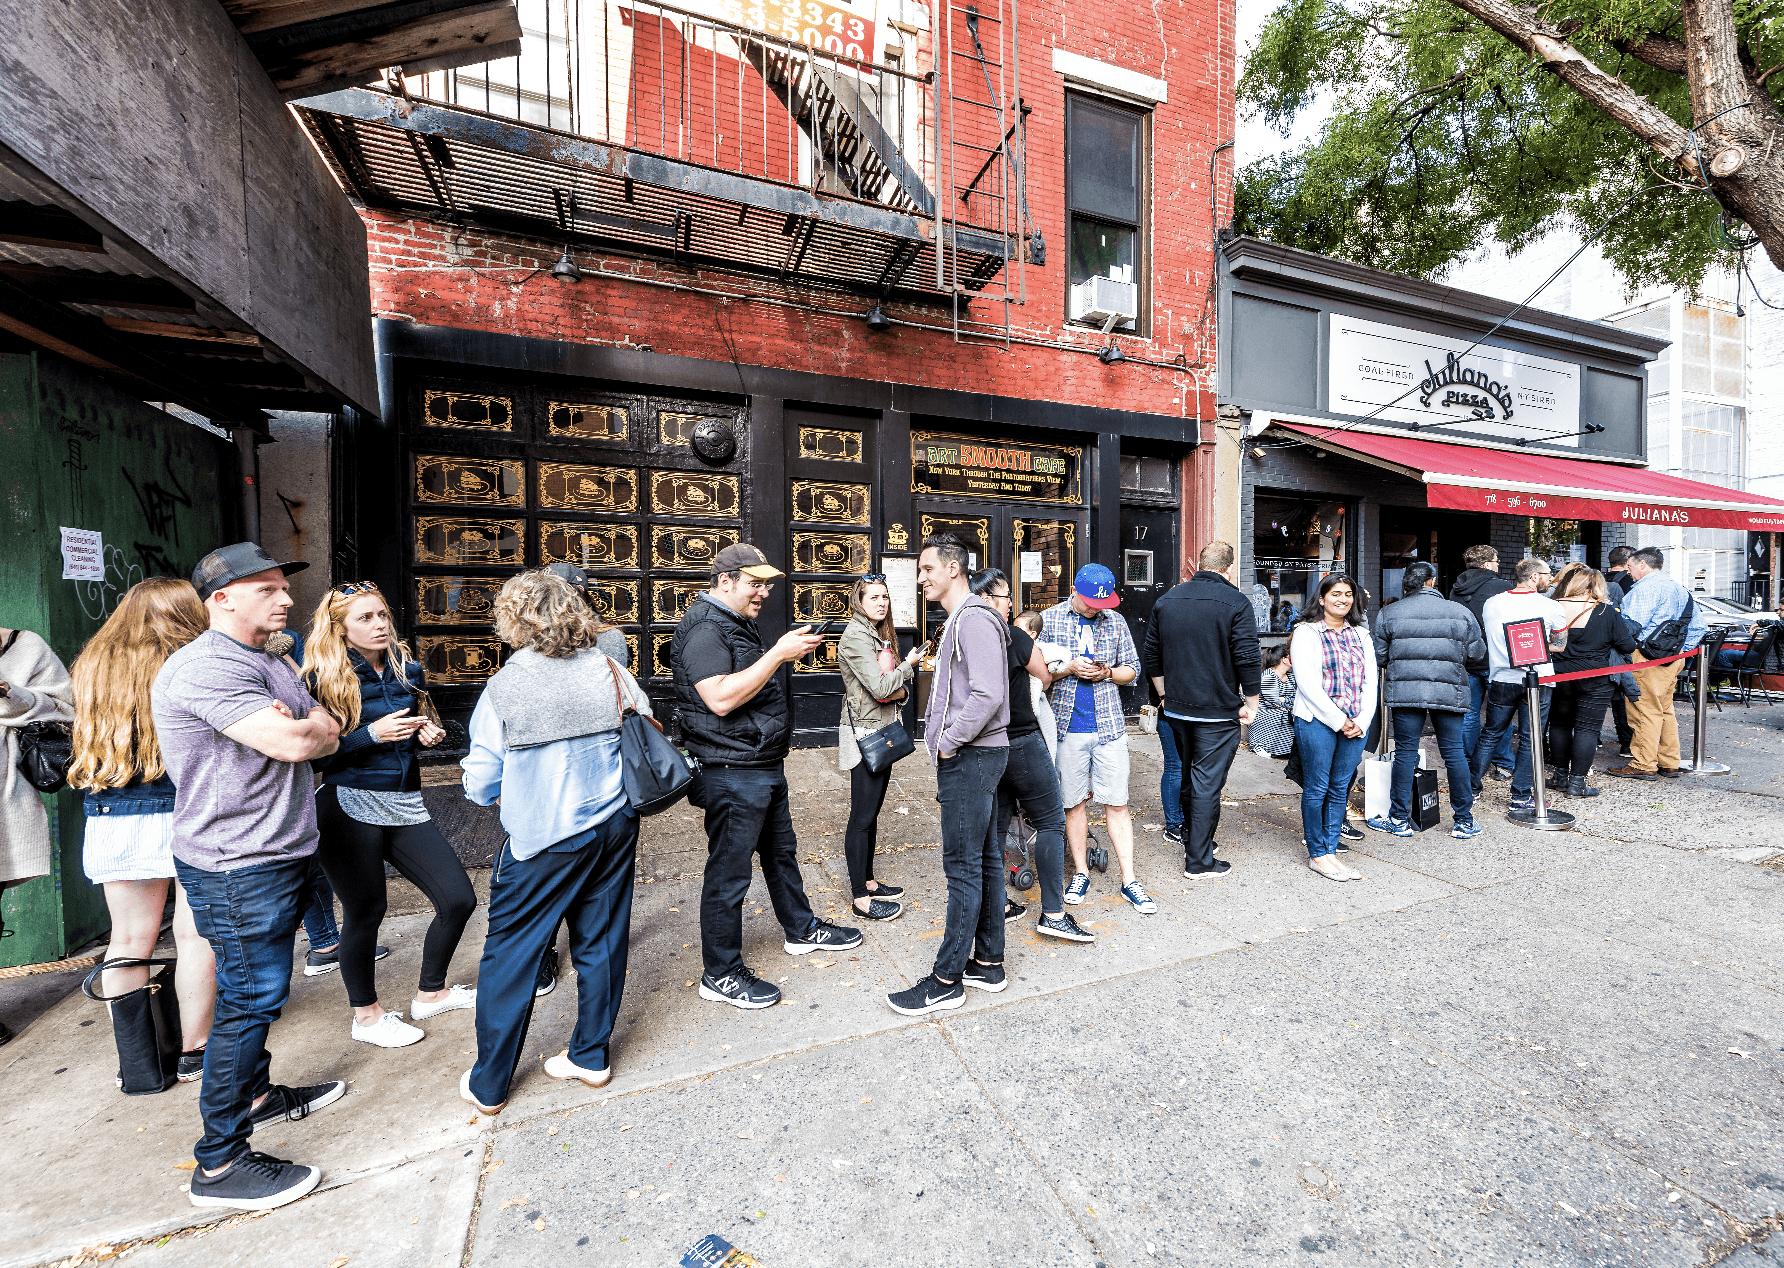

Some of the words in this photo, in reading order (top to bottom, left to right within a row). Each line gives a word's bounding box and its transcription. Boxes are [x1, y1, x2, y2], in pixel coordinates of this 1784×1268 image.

[1446, 390, 1490, 408] PIZZA
[927, 446, 957, 465] ART
[960, 445, 1031, 472] SMOOTH
[1034, 457, 1066, 475] CAFE
[1484, 493, 1497, 506] 718
[1507, 495, 1521, 508] 596
[1529, 496, 1547, 510] 6700
[1622, 506, 1689, 523] JULIANA'S
[1134, 525, 1148, 540] 17
[66, 536, 97, 546] RESIDENTIAL
[887, 543, 908, 551] INSIDE
[65, 545, 98, 555] COMMERCIAL
[71, 554, 96, 563] CLEANING
